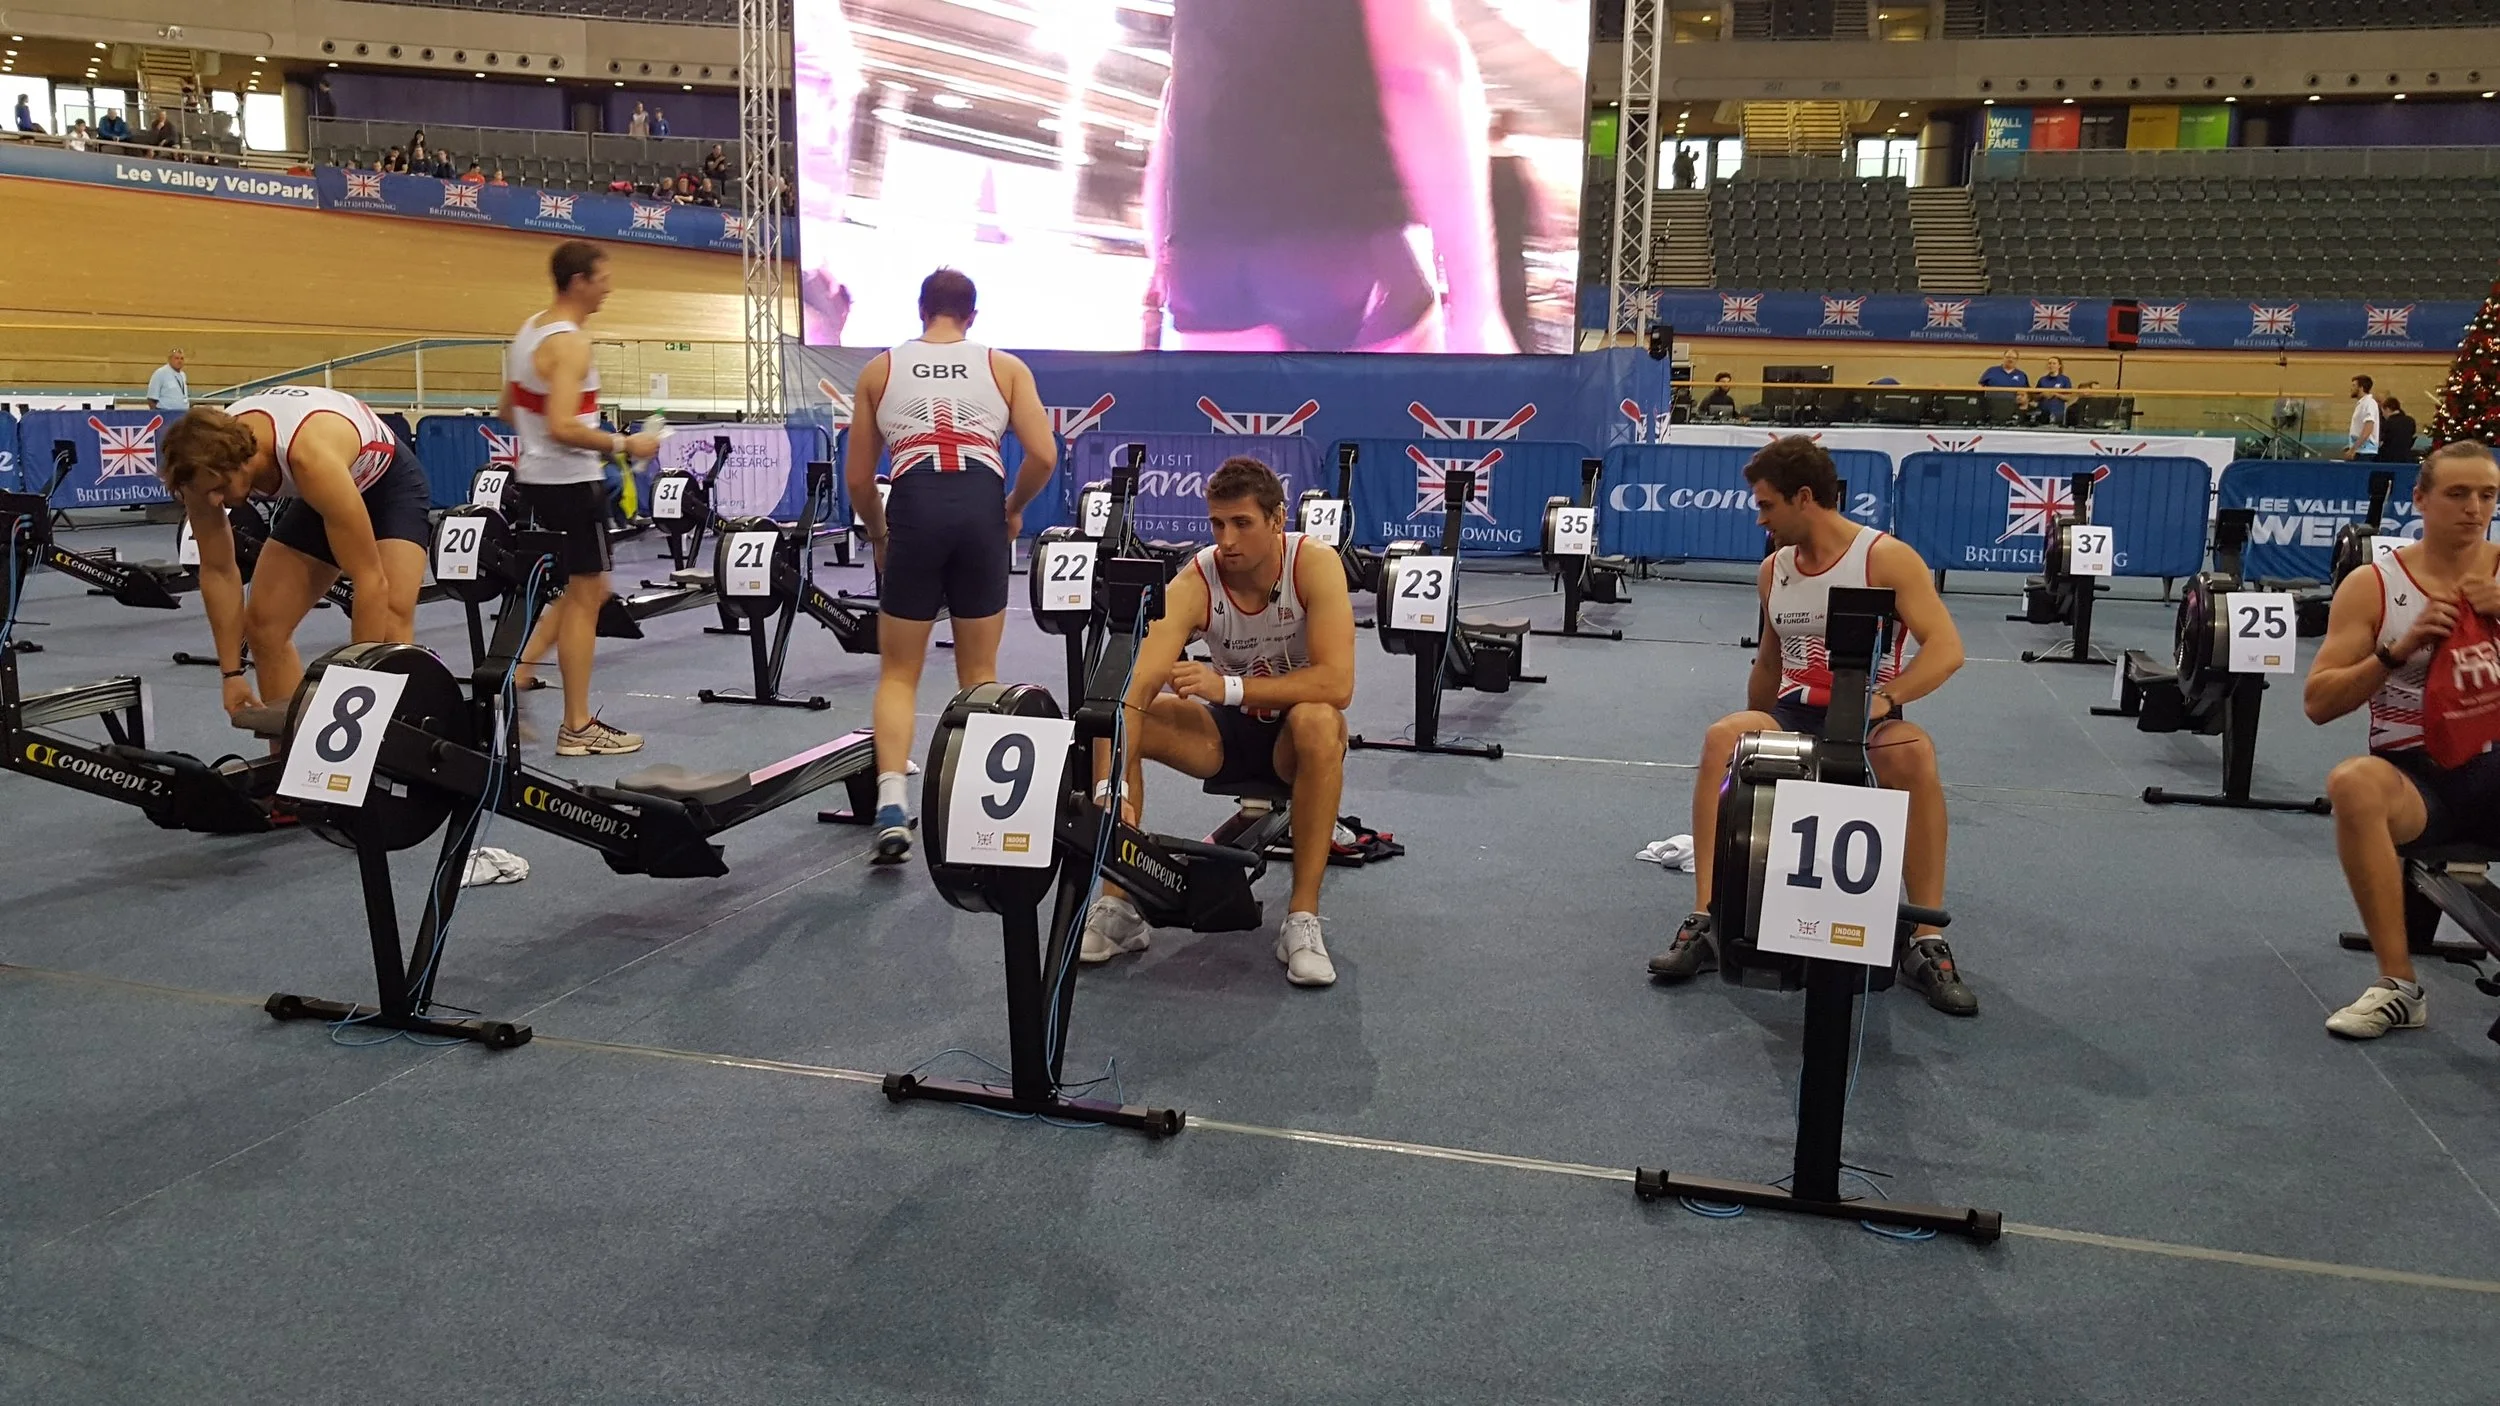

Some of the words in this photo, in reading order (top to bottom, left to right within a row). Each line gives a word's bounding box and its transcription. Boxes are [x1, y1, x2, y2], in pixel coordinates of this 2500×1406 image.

[1989, 117, 2022, 128] WALL
[1988, 128, 2004, 138] OF
[1987, 138, 2019, 149] FAME
[116, 164, 152, 182] Lee
[157, 168, 219, 191] Valley
[224, 175, 314, 200] VeloPark
[912, 364, 968, 379] GBR
[730, 445, 767, 455] ANCER
[1149, 454, 1192, 466] VISIT
[0, 451, 14, 471] 2
[479, 477, 501, 493] 30
[724, 470, 738, 480] UK
[660, 483, 680, 500] 31
[1851, 492, 1877, 516] 2
[2246, 498, 2288, 513] LEE
[2295, 499, 2371, 515] VALLE
[1311, 508, 1337, 525] 34
[1560, 515, 1588, 533] 35
[444, 528, 477, 553] 20
[2078, 534, 2107, 554] 37
[734, 542, 765, 567] 21
[1051, 554, 1088, 581] 22
[1401, 569, 1443, 600] 23
[2239, 606, 2287, 639] 25
[316, 685, 376, 763] 8
[58, 754, 149, 791] concept
[150, 780, 163, 796] 2
[981, 733, 1036, 820] 9
[550, 797, 618, 835] concept
[620, 822, 631, 839] 2
[1786, 815, 1882, 895] 10
[1136, 851, 1177, 888] concept
[1176, 875, 1183, 893] 2
[1835, 926, 1861, 937] INDOOR
